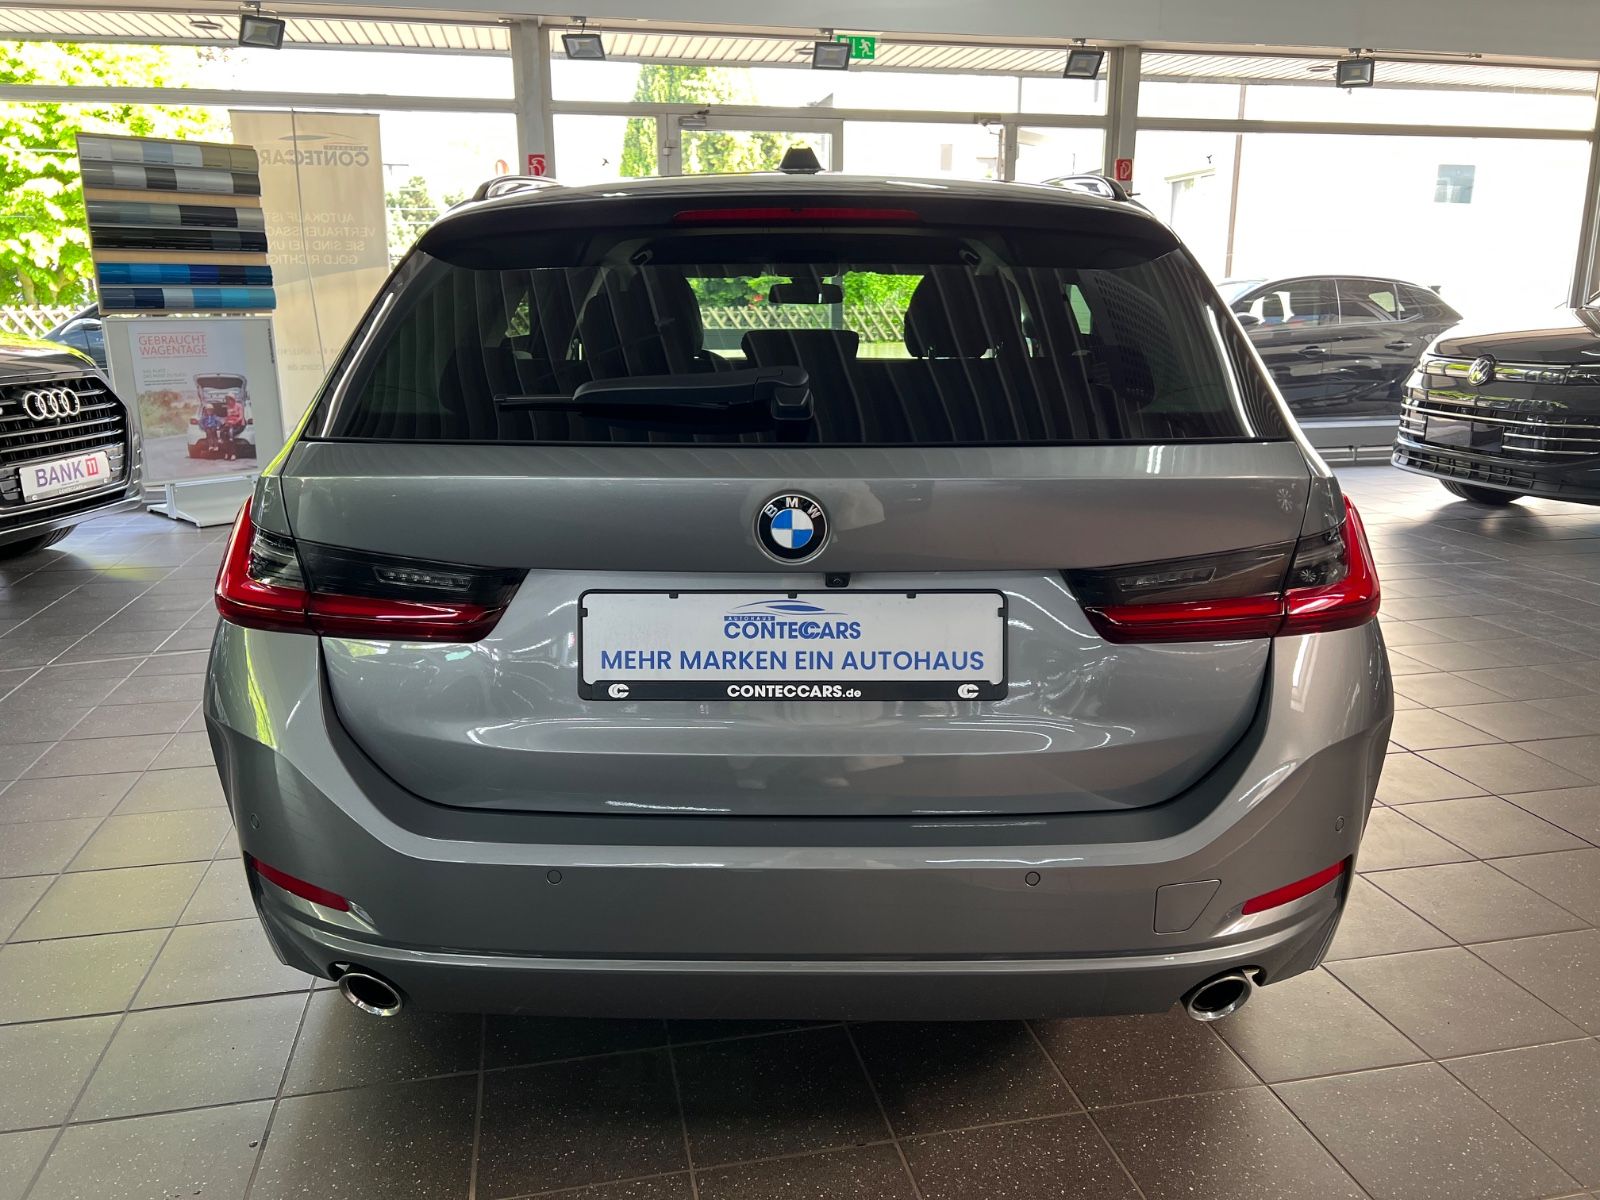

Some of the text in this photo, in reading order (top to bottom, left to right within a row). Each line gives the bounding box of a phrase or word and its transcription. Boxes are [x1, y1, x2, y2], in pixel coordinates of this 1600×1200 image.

[138, 334, 207, 346] GEBRAUCHT
[139, 345, 208, 356] WAGENTAGE
[35, 460, 84, 488] BANK
[764, 497, 821, 519] BMW
[724, 621, 861, 640] CONTECCARS
[600, 650, 984, 670] MEHR MARKEN EIN AUTOHAUS
[727, 684, 862, 698] CONTECCARS.de
